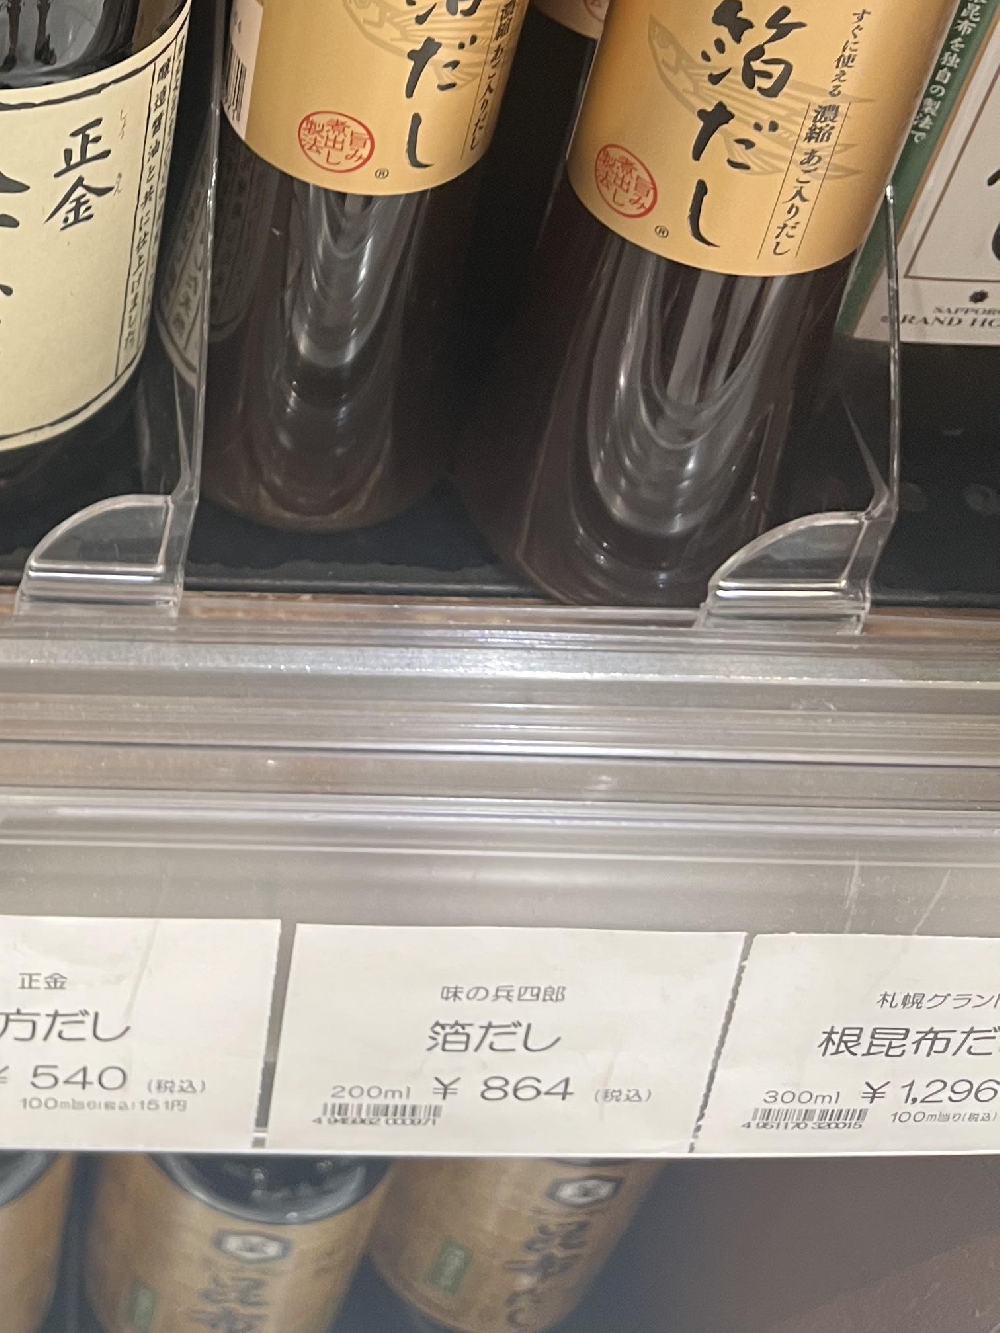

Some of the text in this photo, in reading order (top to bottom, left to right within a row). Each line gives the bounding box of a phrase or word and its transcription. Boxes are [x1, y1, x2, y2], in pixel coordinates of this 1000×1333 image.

[828, 8, 872, 98] すぐに使える
[44, 116, 116, 232] 正金
[17, 972, 69, 990] 正金
[440, 984, 567, 1003] 味の兵四郎
[425, 1020, 562, 1054] 箔だし
[29, 1065, 128, 1091] 540
[146, 1078, 207, 1094] (税込)
[330, 1076, 652, 1103] 200ml ¥ 864 (税込)
[762, 1078, 1000, 1105] 300ml ¥ 1,296
